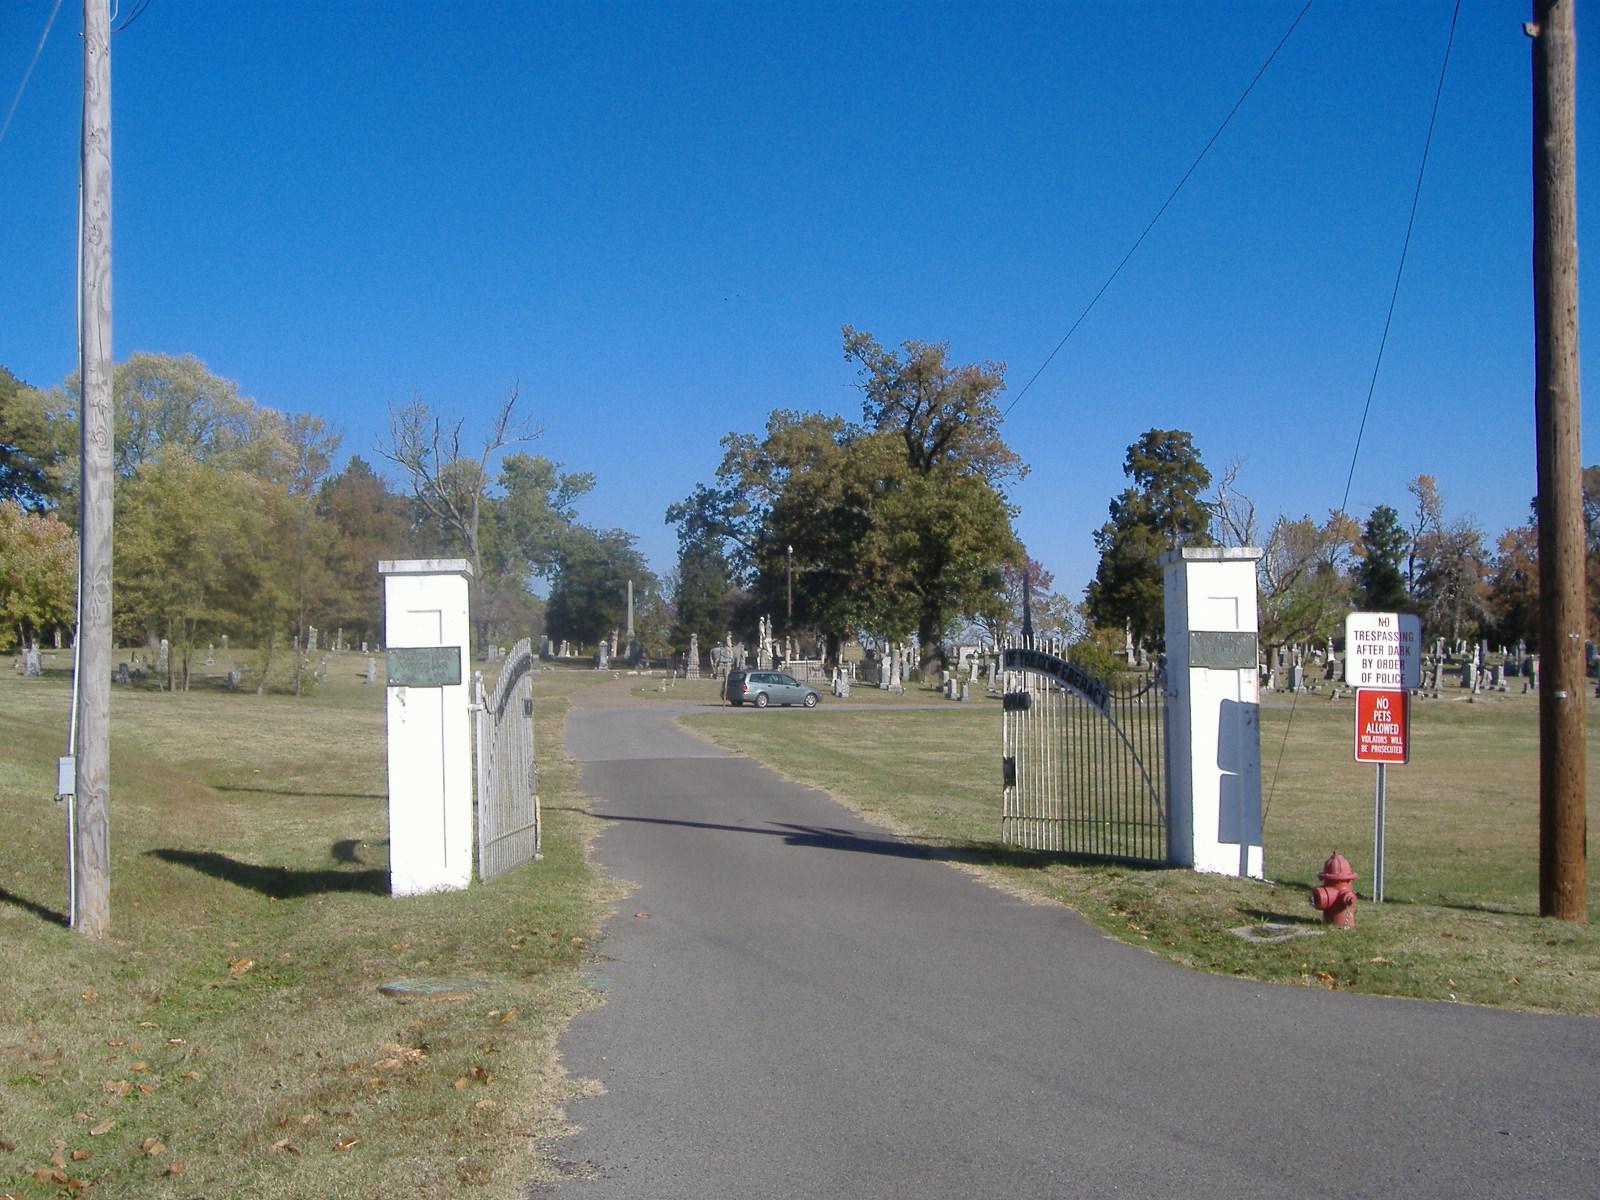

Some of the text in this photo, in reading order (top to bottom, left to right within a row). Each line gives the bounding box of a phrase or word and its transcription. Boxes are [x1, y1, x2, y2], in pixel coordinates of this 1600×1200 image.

[1378, 617, 1390, 627] NO
[1353, 630, 1414, 642] TRESPASSING
[1356, 644, 1411, 656] AFTER DARK
[1362, 659, 1405, 671] BY ORDER
[1361, 673, 1405, 684] OF POLICE
[1376, 697, 1389, 709] NO
[1373, 710, 1392, 722] PETS
[1366, 722, 1399, 735] ALLOWED
[1361, 735, 1403, 745] VIOLATORS WILL
[1361, 744, 1403, 754] BE PROSECUTED
